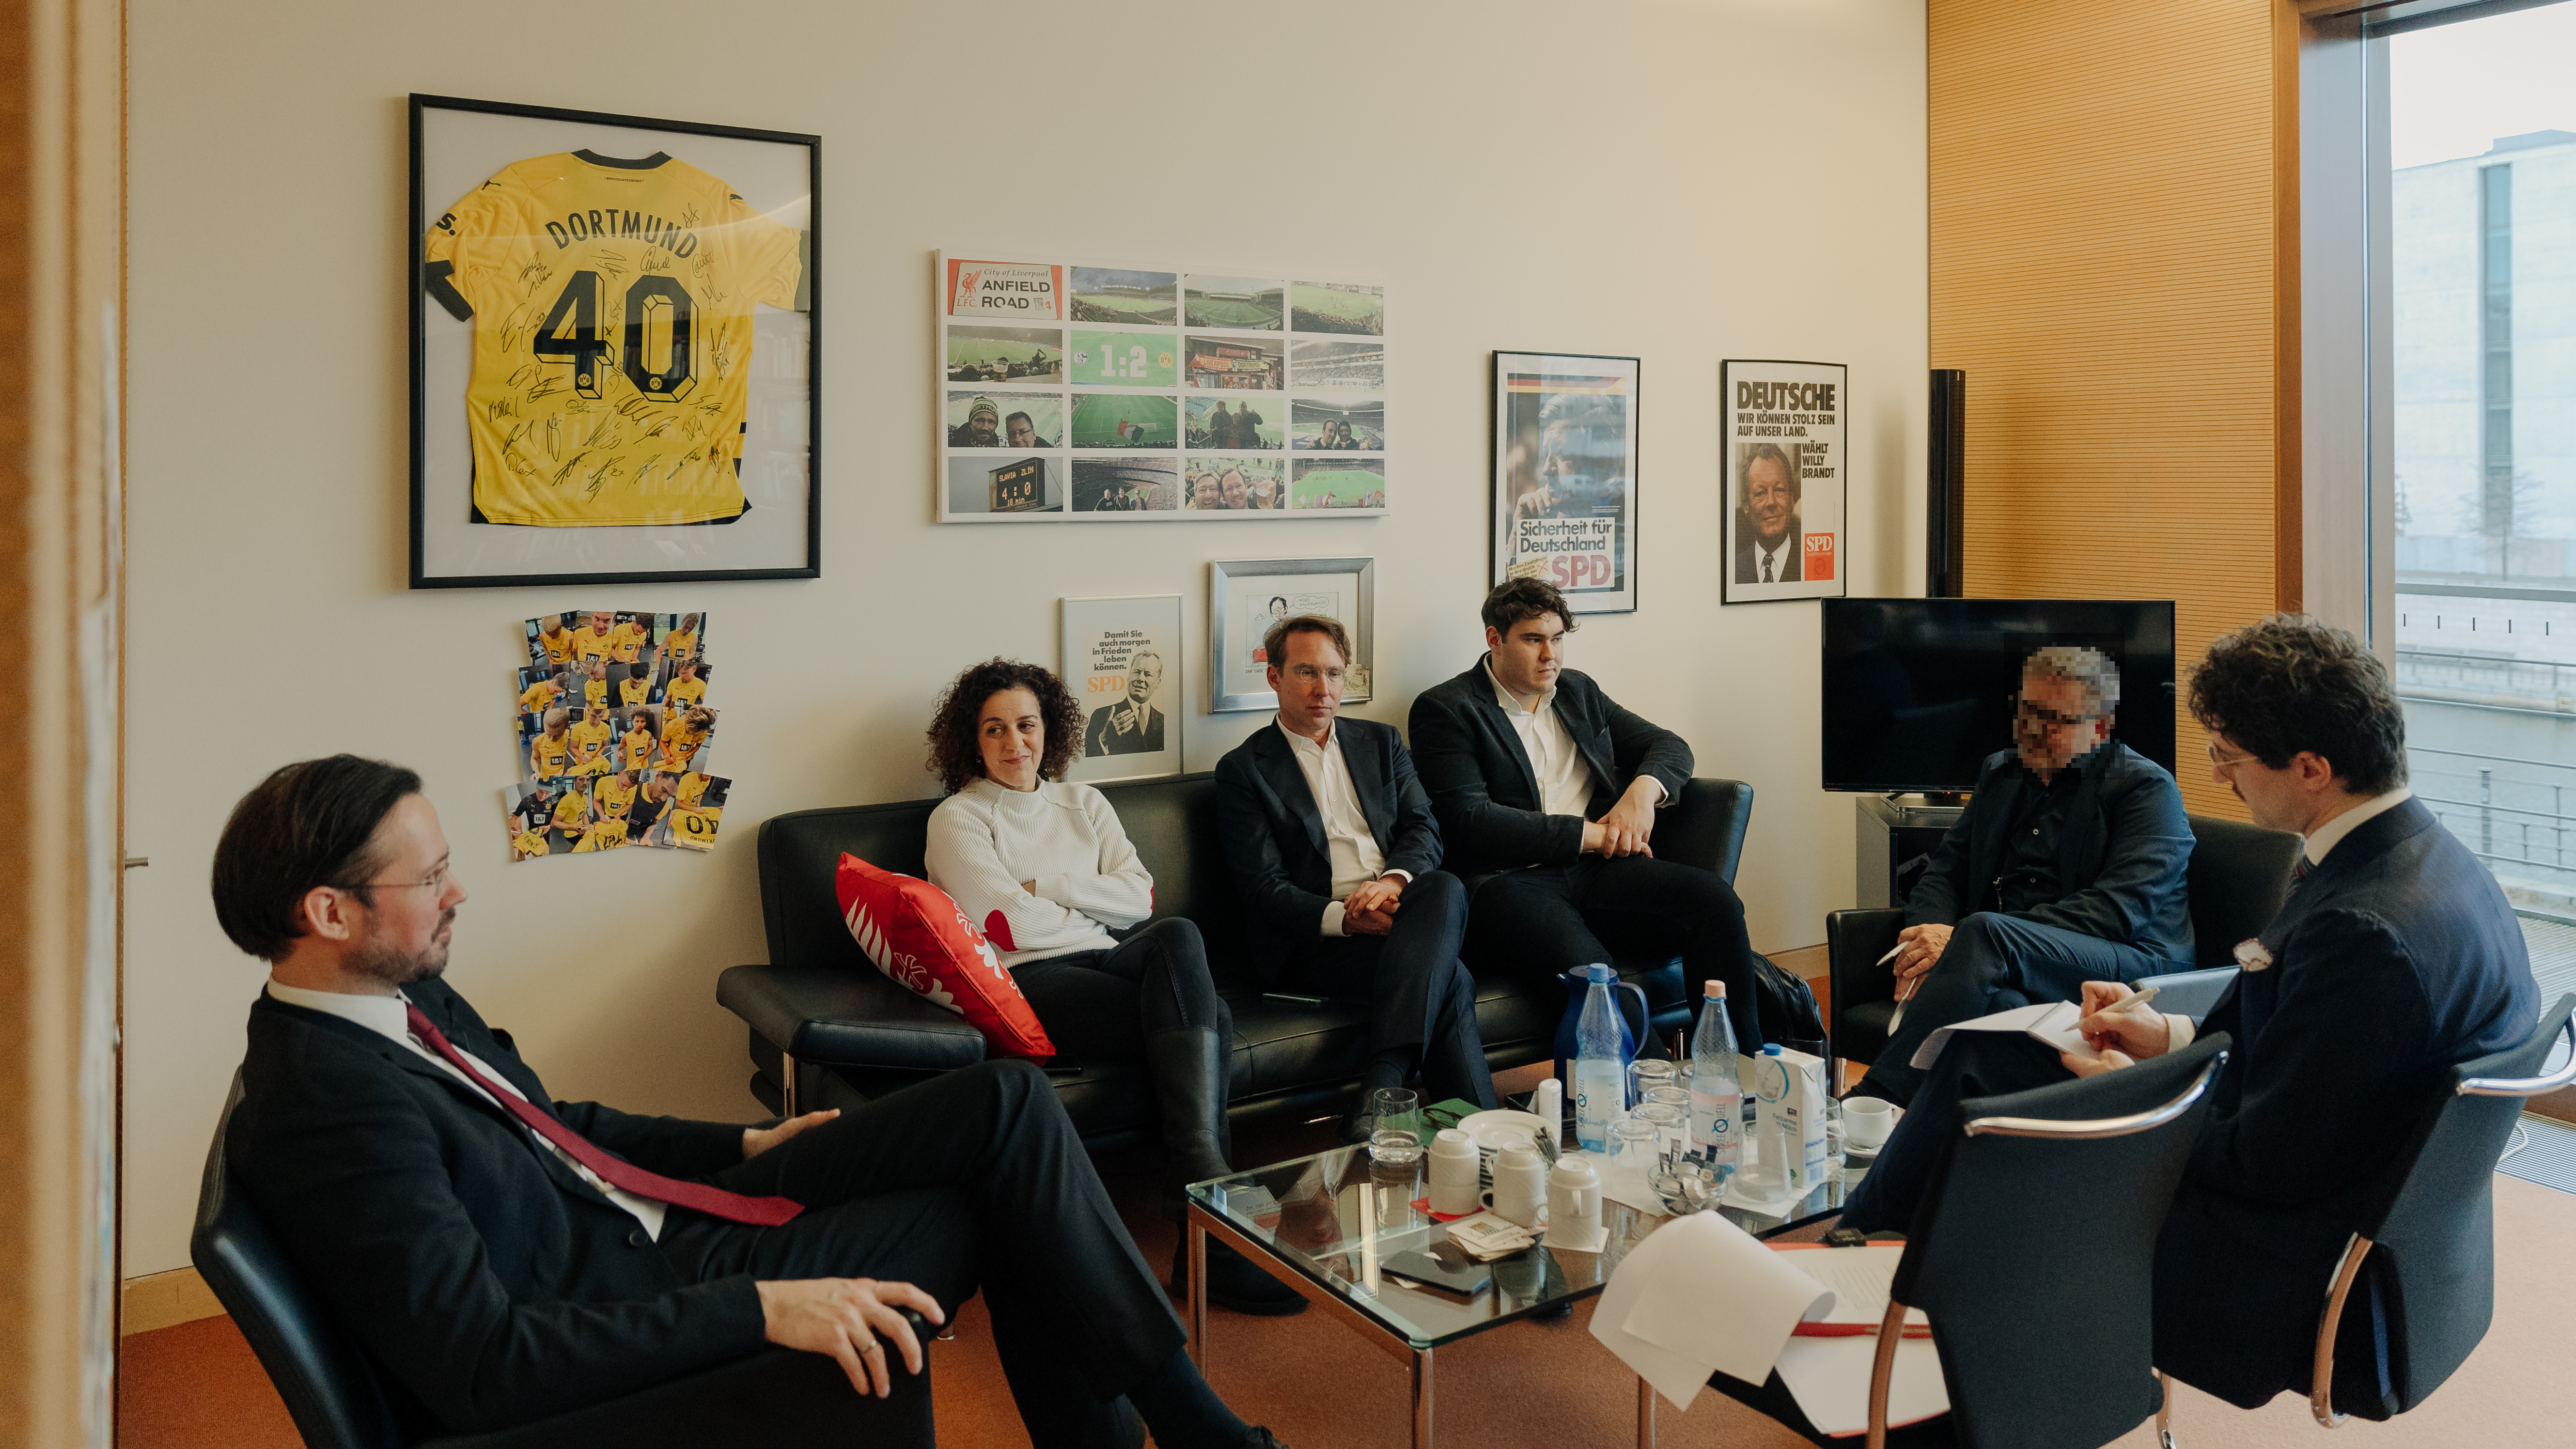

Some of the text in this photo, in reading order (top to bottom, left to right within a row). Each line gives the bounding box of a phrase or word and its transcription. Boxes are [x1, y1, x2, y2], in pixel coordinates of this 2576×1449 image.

[545, 209, 697, 258] DORTMUND
[1012, 270, 1048, 278] Liverpool
[982, 280, 1050, 292] ANFIELD
[957, 298, 977, 307] L.F.C.
[982, 296, 1030, 309] ROAD
[1046, 301, 1052, 310] 4
[533, 270, 699, 403] 40
[1101, 345, 1147, 377] 1:2
[1161, 355, 1171, 363] BVB
[1737, 381, 1835, 411] DEUTSCHE
[1737, 410, 1835, 425] WIR KÖNNEN STOLZ SEIN
[1737, 425, 1808, 436] AUF UNSER LAND.
[1802, 439, 1828, 453] WÄHLT
[1802, 455, 1825, 466] WILLY
[999, 471, 1016, 482] SLAVIA
[1802, 467, 1835, 479] BRANDT
[1002, 487, 1007, 500] 4
[1520, 519, 1612, 536] Sicherheit für
[1520, 535, 1606, 553] Deutschland
[1807, 536, 1833, 551] SPD
[1552, 554, 1611, 588] SPD
[1105, 630, 1129, 639] Damit
[1101, 647, 1132, 655] Frieden
[1094, 663, 1127, 671] können.
[1087, 675, 1125, 693] SPD
